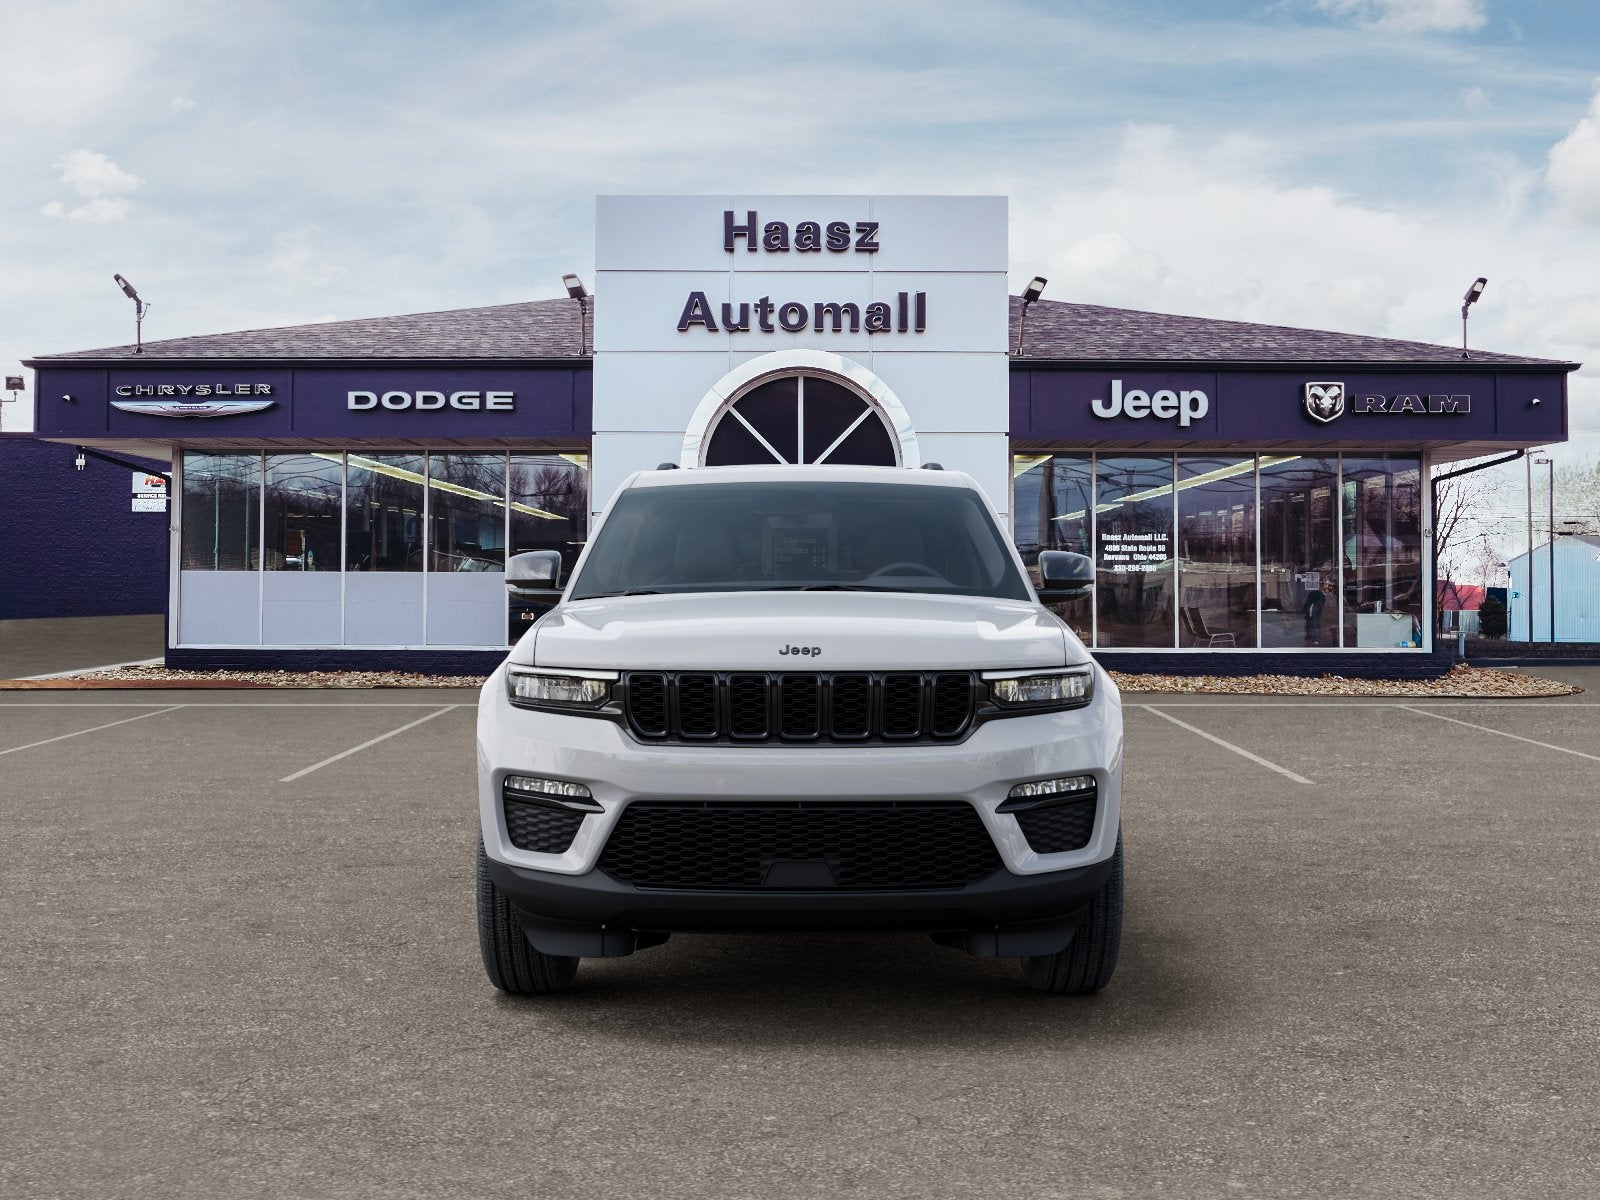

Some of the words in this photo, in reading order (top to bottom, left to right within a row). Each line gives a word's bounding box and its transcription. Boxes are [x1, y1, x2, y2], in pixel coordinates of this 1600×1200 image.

[723, 210, 880, 252] Haasz
[676, 291, 927, 332] Automall
[115, 383, 271, 396] CHRYSLER
[347, 390, 514, 410] DODGE
[1091, 379, 1209, 427] Jeep
[1354, 394, 1471, 413] RAM
[778, 644, 822, 658] Jeep
